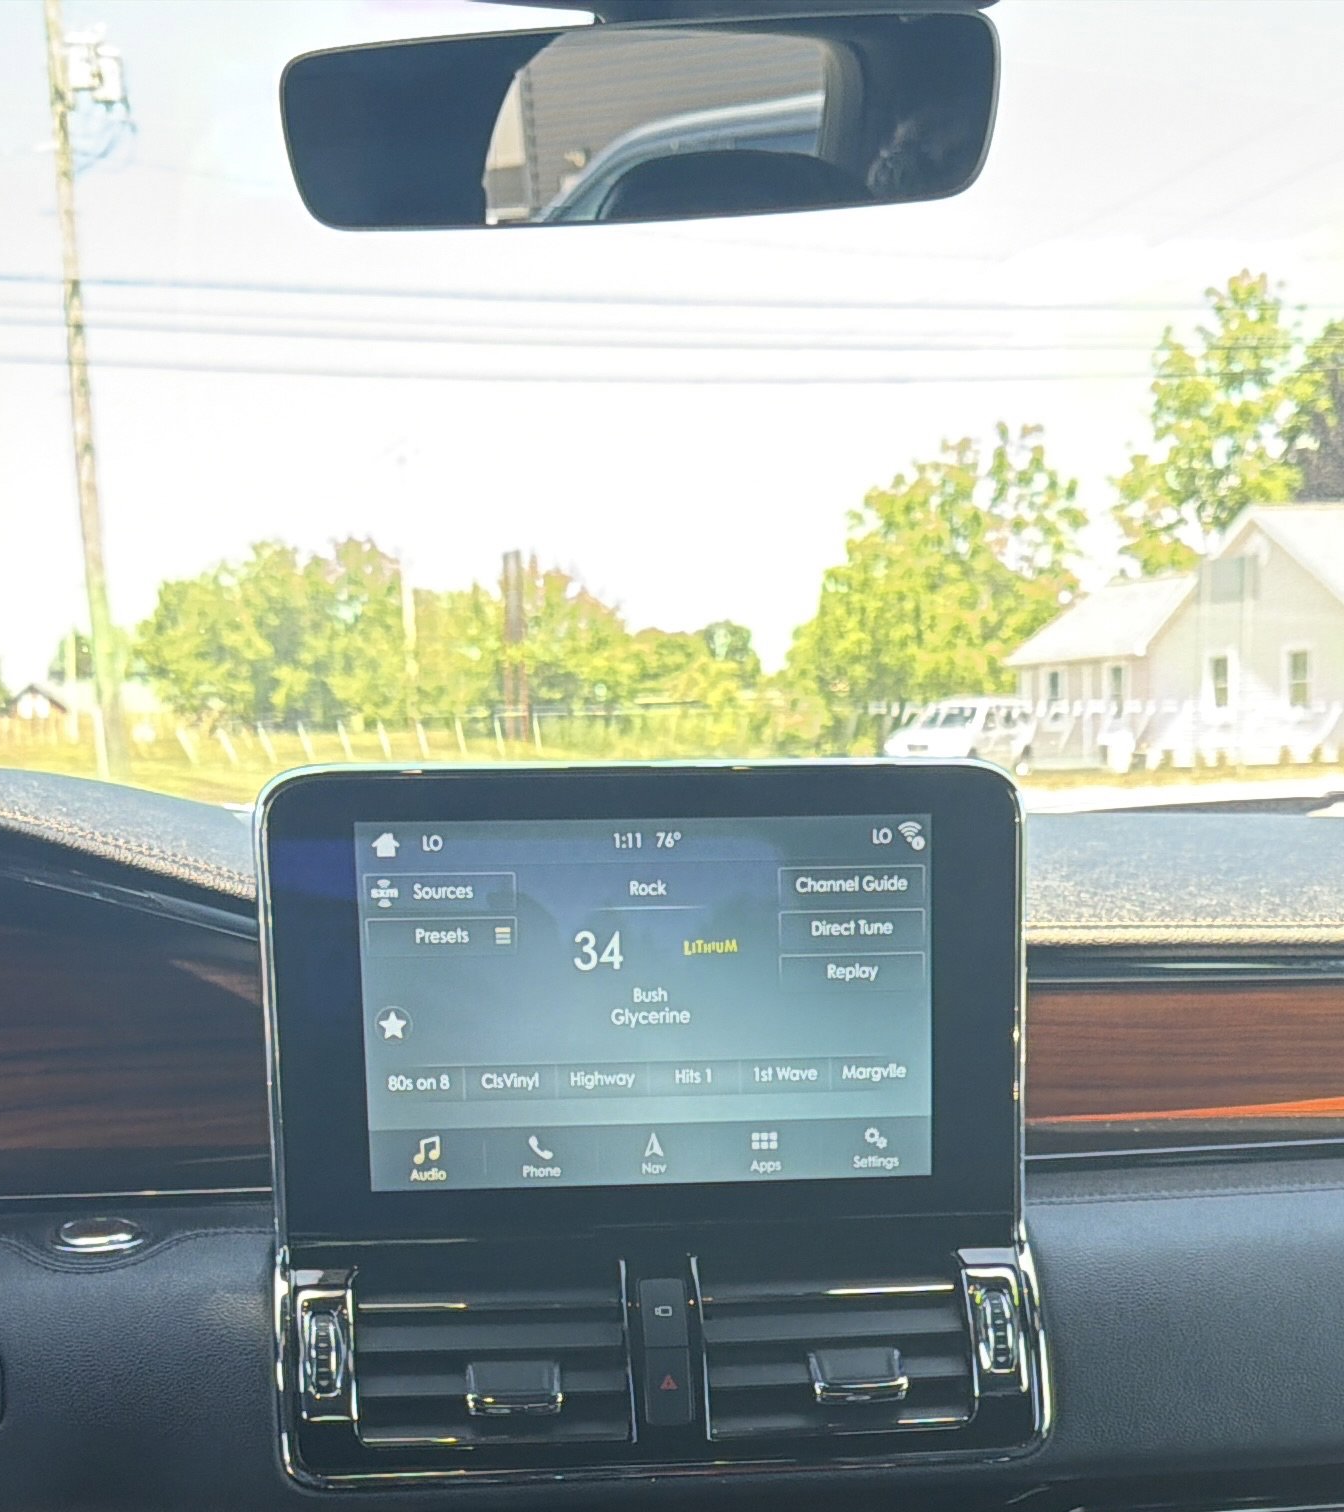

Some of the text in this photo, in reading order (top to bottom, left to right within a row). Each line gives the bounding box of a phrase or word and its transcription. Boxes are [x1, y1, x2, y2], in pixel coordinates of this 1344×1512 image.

[422, 834, 443, 852] LO
[613, 831, 682, 849] 1:11 76°
[872, 827, 893, 845] LO
[413, 883, 474, 900] Sources
[629, 880, 667, 897] Rock
[795, 875, 909, 893] Channel Guide
[415, 927, 470, 944] Presets
[811, 919, 894, 937] Direct Tune
[573, 930, 624, 971] 34
[826, 963, 879, 982] Replay
[632, 987, 668, 1003] Bush
[611, 1006, 691, 1028] Glycerine
[481, 1072, 540, 1092] ClsVinyl
[570, 1071, 636, 1090] Highway
[675, 1068, 712, 1084] Hits 1
[754, 1066, 818, 1082] 1st Wave
[387, 1074, 450, 1092] 80s on 8
[641, 1162, 667, 1175] Nav
[750, 1160, 782, 1174] Apps
[853, 1155, 900, 1170] Settings
[410, 1168, 447, 1182] Audio
[522, 1165, 561, 1178] Phone
